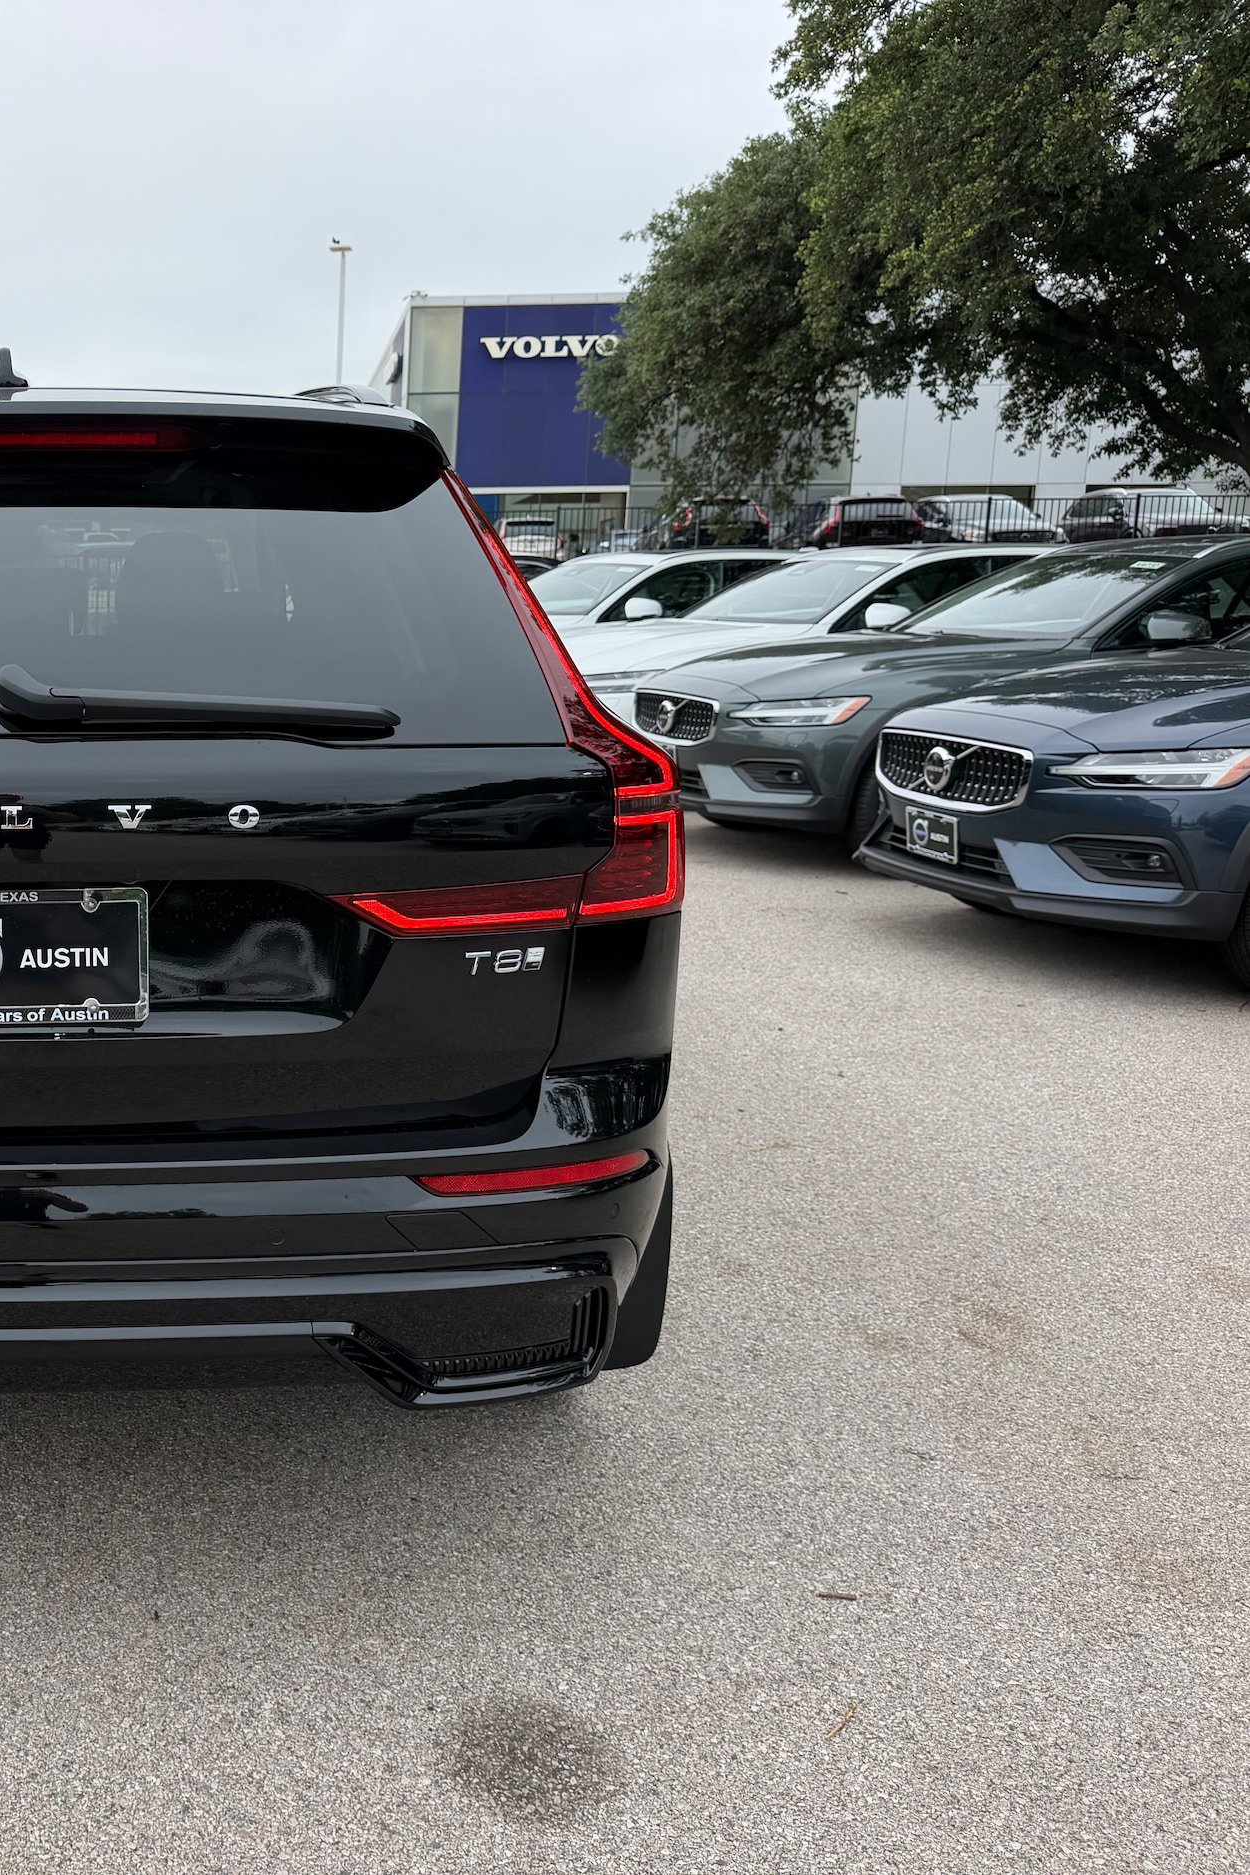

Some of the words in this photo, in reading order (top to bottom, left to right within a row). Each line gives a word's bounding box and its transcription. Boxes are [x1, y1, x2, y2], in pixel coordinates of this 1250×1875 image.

[480, 334, 620, 359] VOLVO
[19, 947, 109, 968] AUSTIN
[26, 1008, 46, 1022] of
[50, 1007, 110, 1021] Austin
